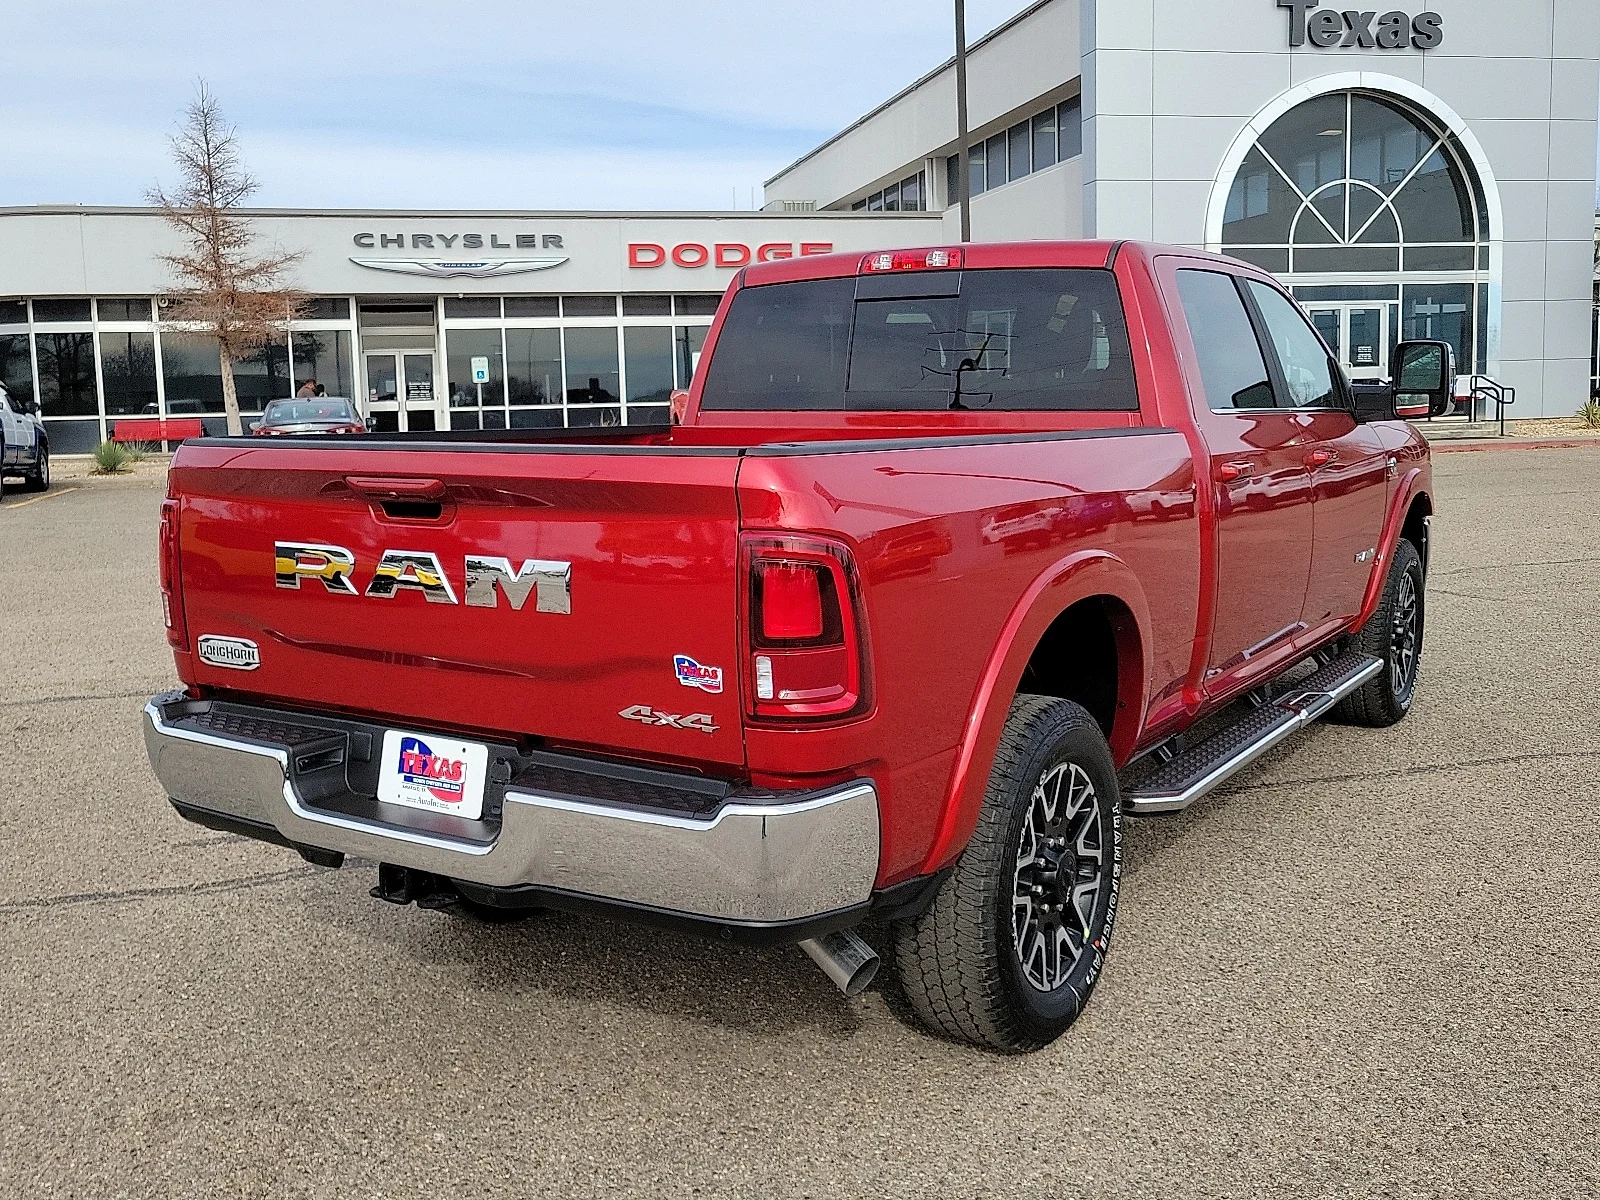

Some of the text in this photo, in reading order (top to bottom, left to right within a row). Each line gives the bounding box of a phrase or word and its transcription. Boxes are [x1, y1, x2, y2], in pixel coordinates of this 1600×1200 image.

[1277, 0, 1443, 49] Texas
[353, 233, 564, 249] CHRYSLER
[275, 541, 571, 614] RAM
[200, 642, 256, 661] LONGHORN
[679, 664, 719, 680] TEXAS
[402, 751, 462, 781] TEXAS
